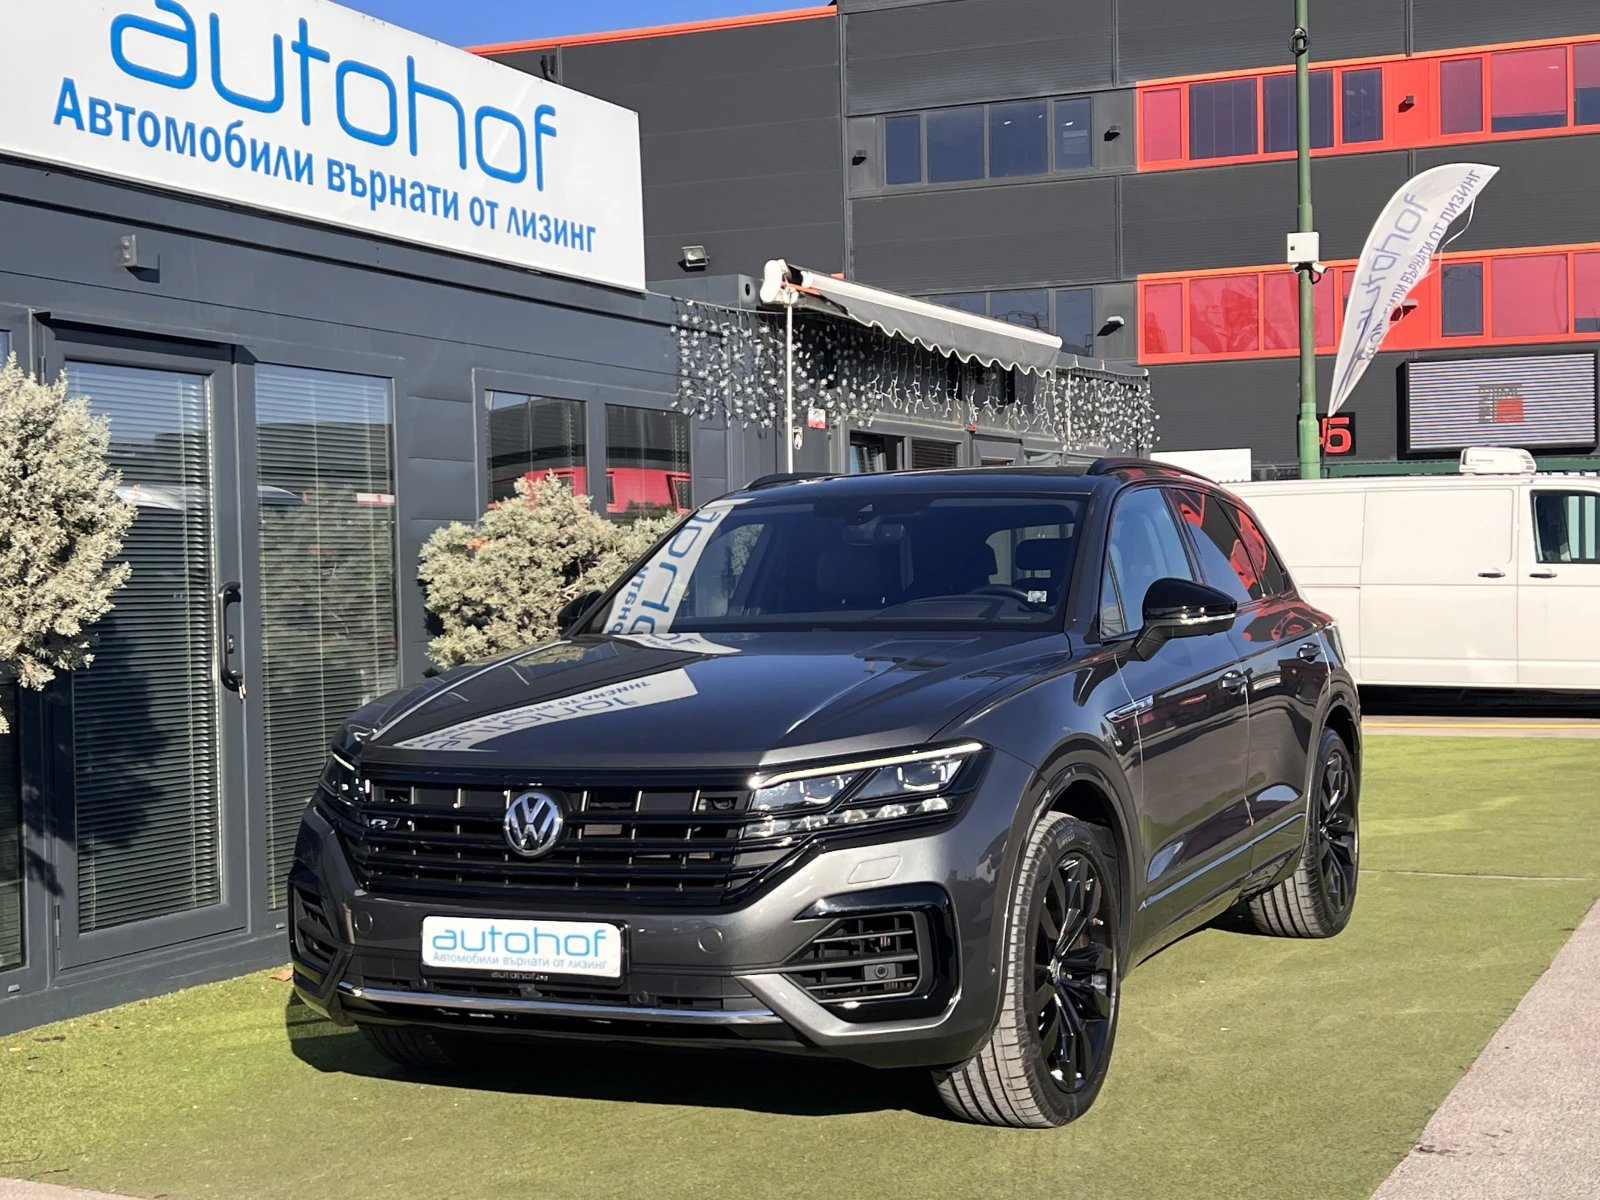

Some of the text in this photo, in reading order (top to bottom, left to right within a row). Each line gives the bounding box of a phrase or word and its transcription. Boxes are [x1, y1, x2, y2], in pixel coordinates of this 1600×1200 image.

[110, 0, 557, 191] autohof
[53, 77, 596, 253] Автомобили върнати от лизинг
[1400, 241, 1435, 284] ВЪРНАТИ
[1429, 222, 1444, 242] ОТ
[432, 925, 607, 957] autohof
[433, 951, 608, 970] Автомобили върнати от лизинг
